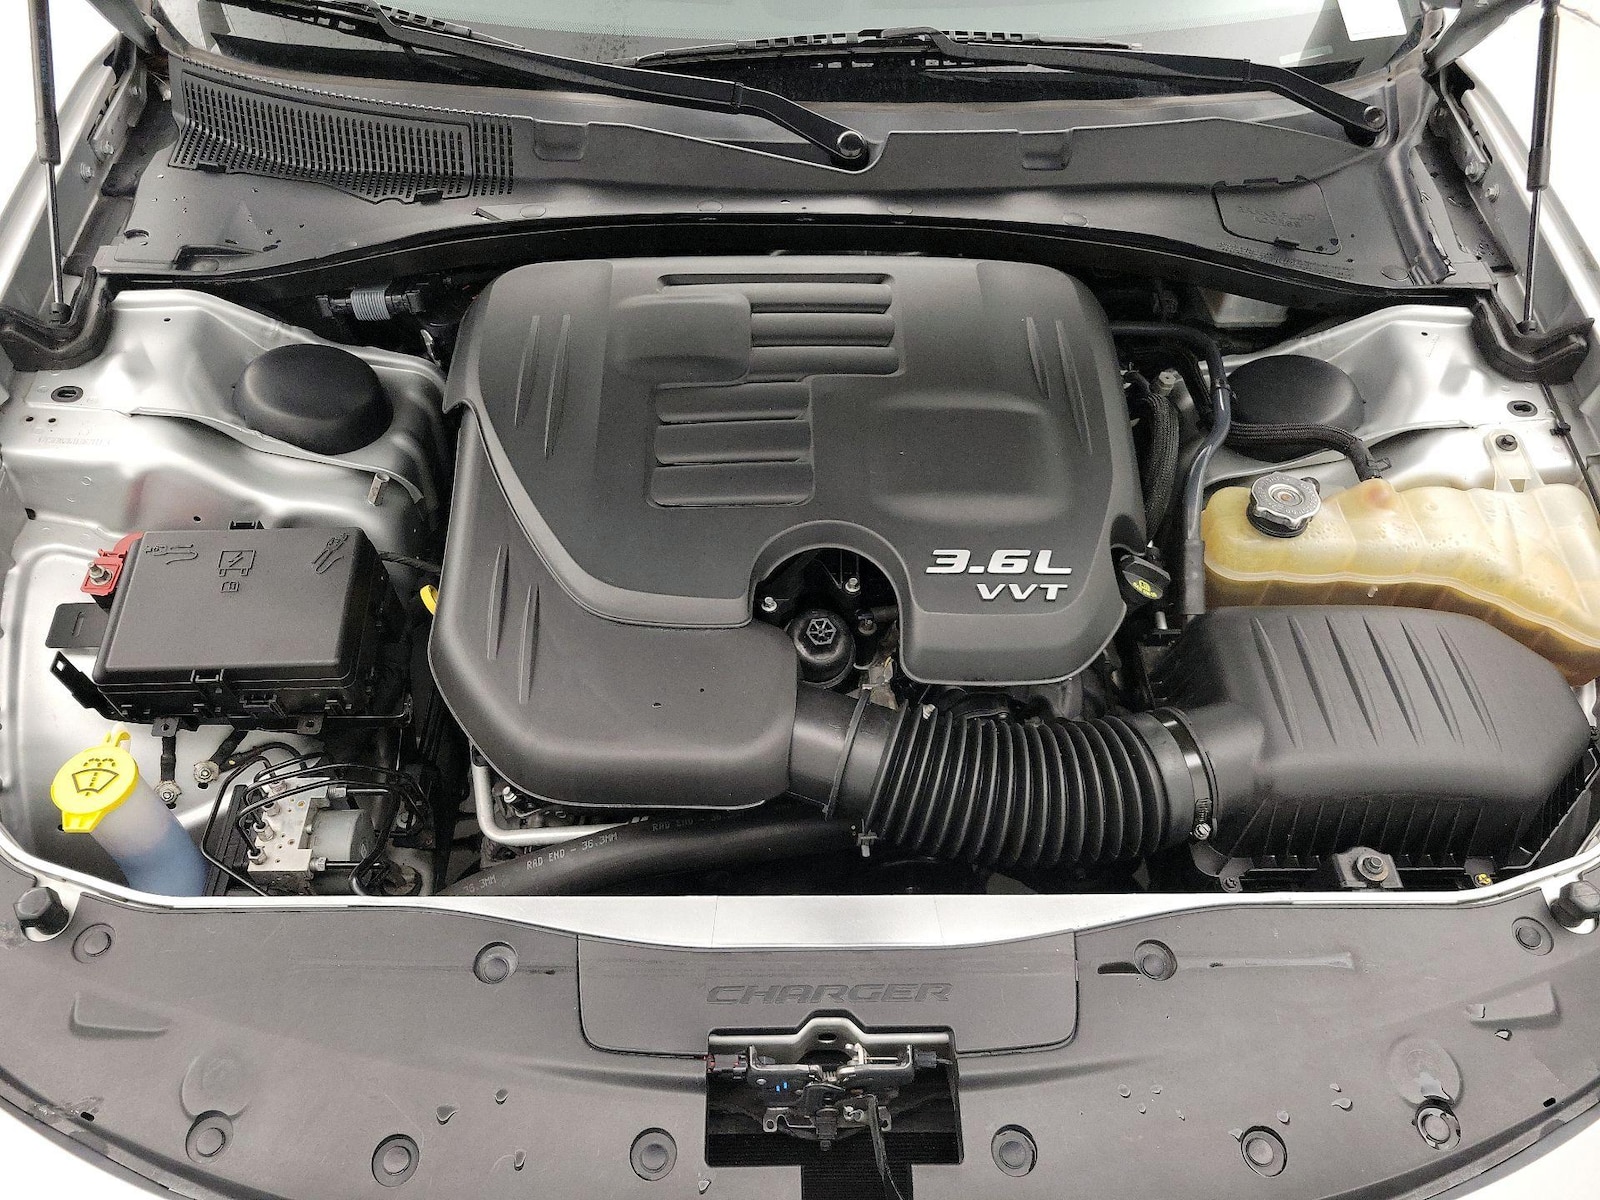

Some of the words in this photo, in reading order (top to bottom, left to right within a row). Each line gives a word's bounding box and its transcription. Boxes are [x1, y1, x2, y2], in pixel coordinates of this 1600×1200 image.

[926, 550, 1072, 574] 3.6L
[976, 584, 1068, 600] VVT
[526, 856, 543, 870] RAD
[548, 848, 565, 862] END
[581, 832, 618, 851] 36.3MM
[706, 982, 953, 1005] CHARGER
